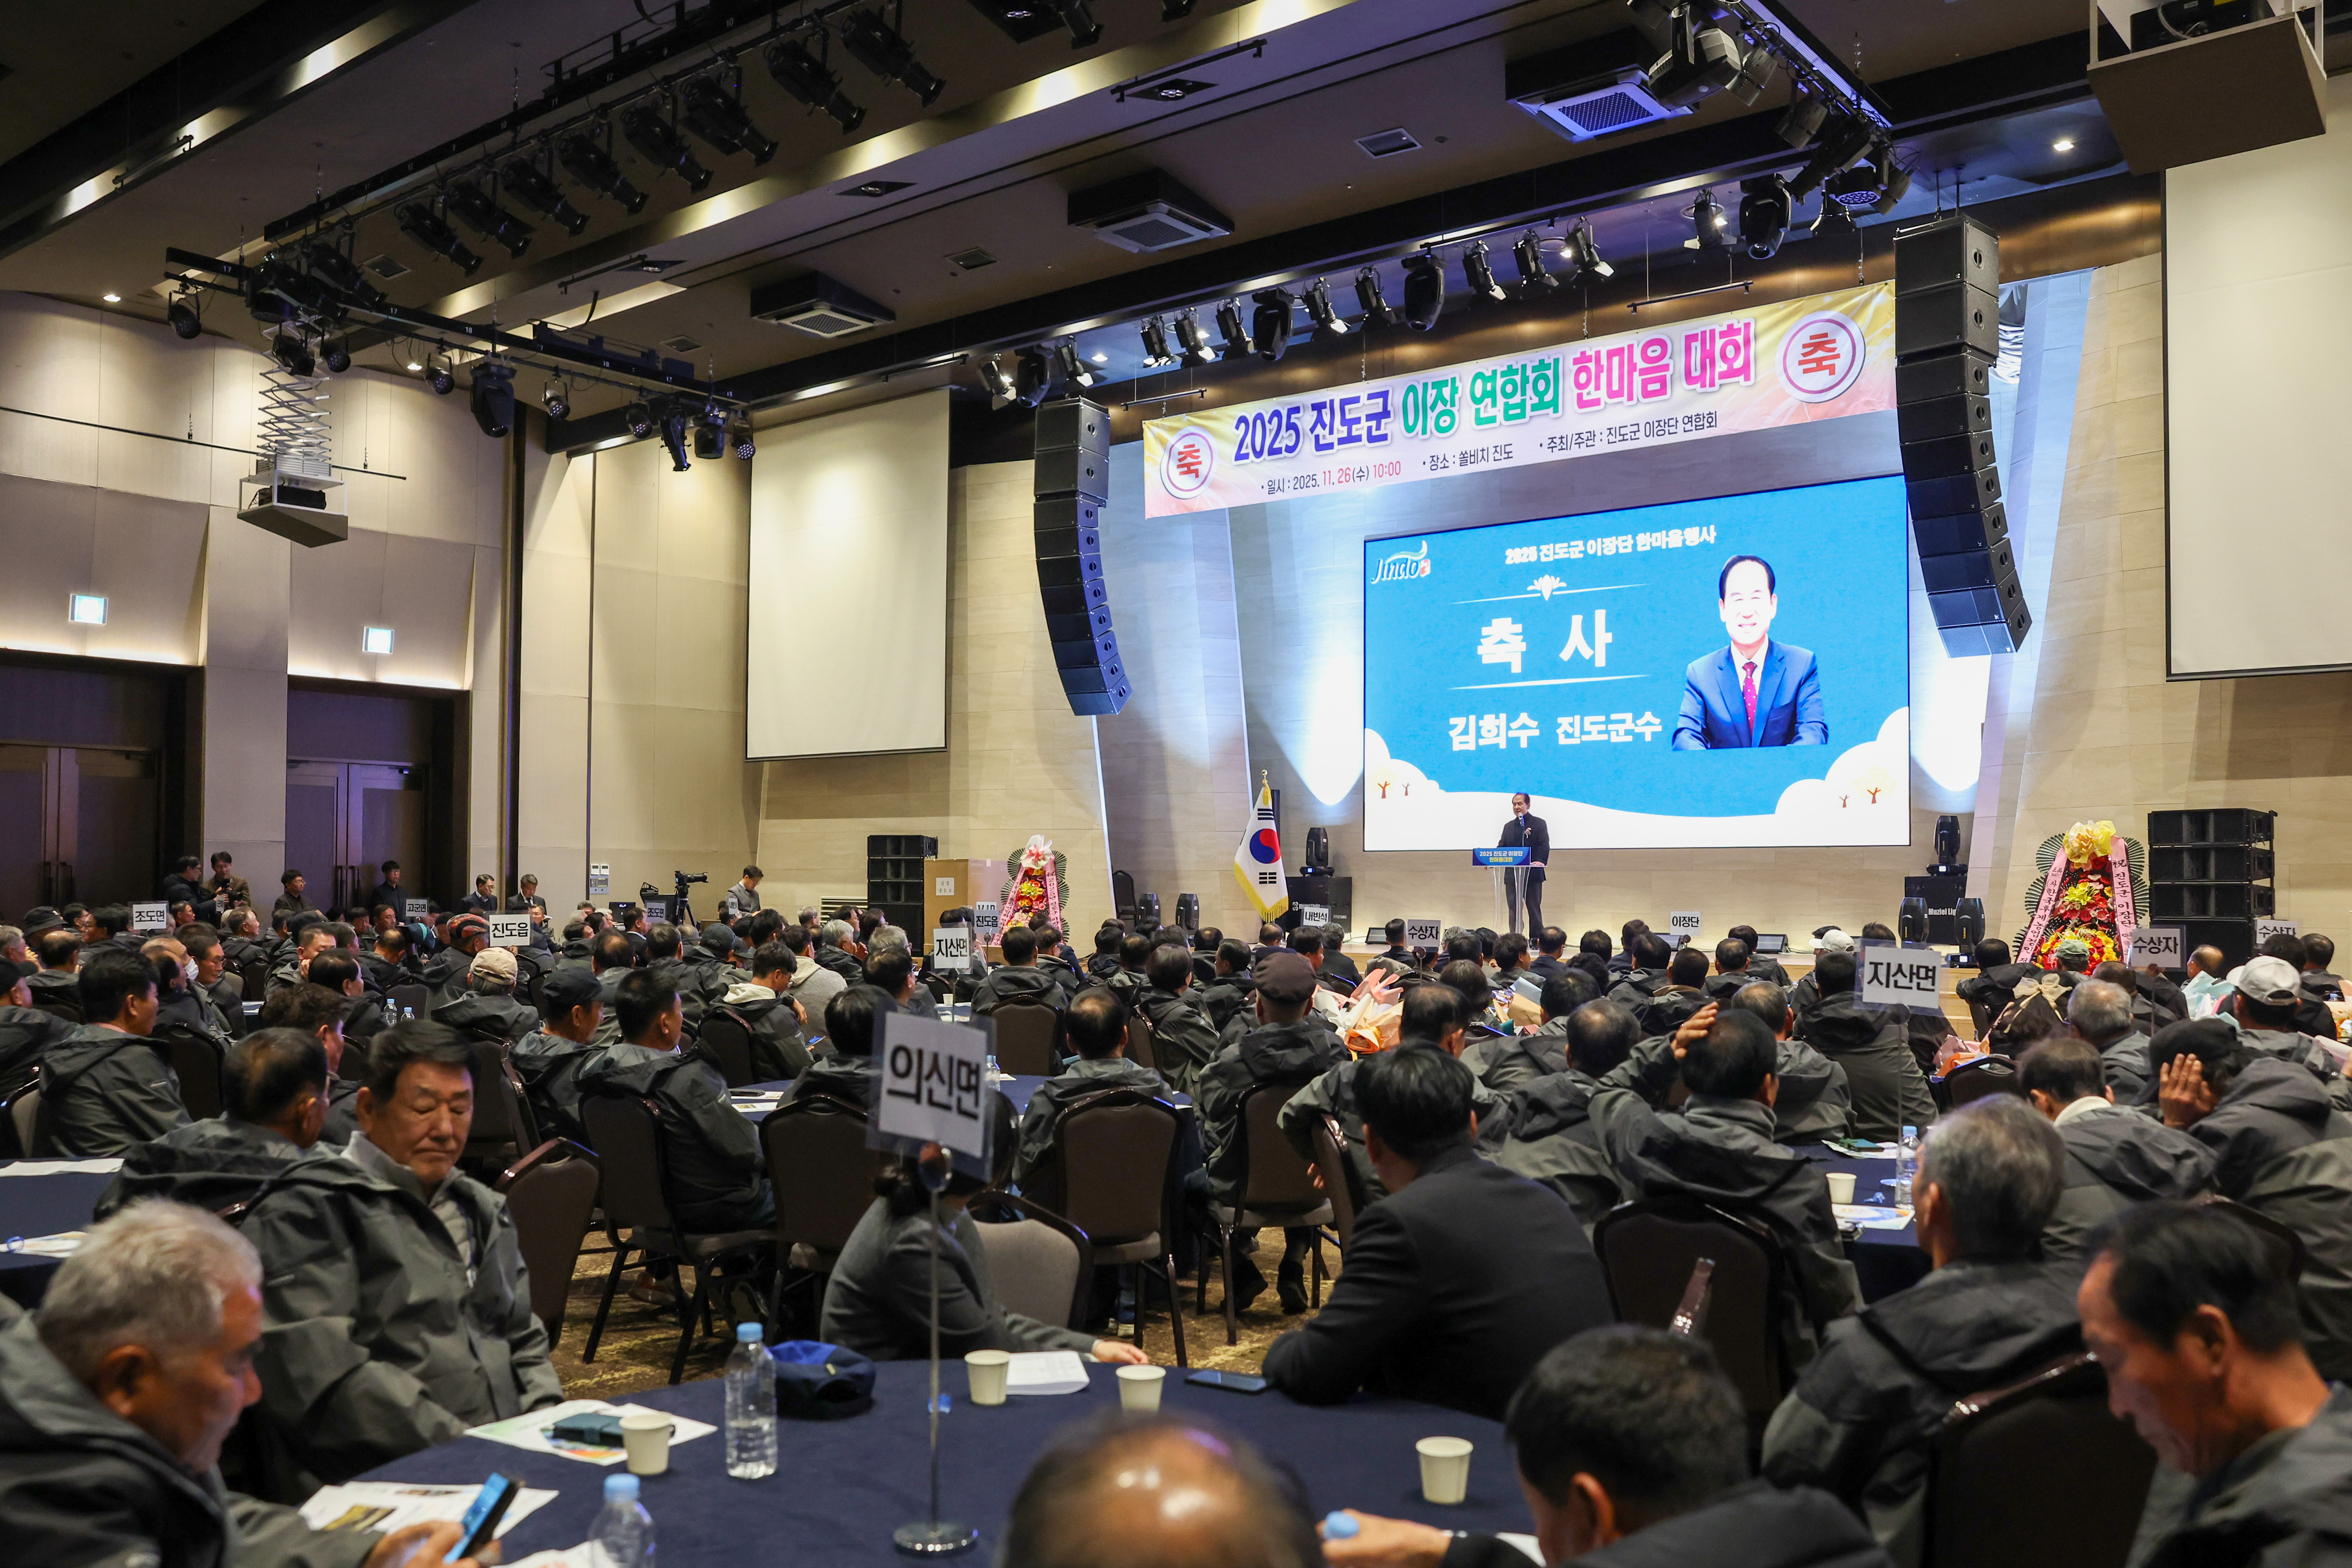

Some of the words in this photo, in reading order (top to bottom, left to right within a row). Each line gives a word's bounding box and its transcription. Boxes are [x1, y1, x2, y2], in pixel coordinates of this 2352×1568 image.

[223, 265, 232, 273] 17
[1799, 333, 1839, 375] 축
[1235, 407, 1300, 461] 2025
[1310, 390, 1390, 451] 진도군
[1403, 377, 1458, 435] 이장
[1470, 358, 1559, 425] 연합회
[1573, 339, 1669, 408] 한마음
[1685, 323, 1750, 388] 대회
[1548, 430, 1596, 453] 주최/주관
[1607, 423, 1640, 444] 진도군
[1645, 417, 1678, 437] 이장단
[1682, 411, 1717, 432] 연합회
[1178, 445, 1201, 477] 축
[1430, 454, 1449, 470] 장소
[1459, 447, 1488, 466] 쏠비치
[1493, 444, 1513, 461] 진도
[1268, 478, 1284, 494] 일시
[1294, 474, 1319, 490] 2025.
[1323, 470, 1334, 485] 11.
[1374, 461, 1400, 477] 10:00
[1505, 548, 1537, 564] 2025
[1539, 541, 1585, 561] 진도군
[1587, 535, 1633, 556] 이장단
[1636, 525, 1717, 551] 한마음행사
[1449, 713, 1539, 751] 김희수
[1556, 711, 1662, 744] 진도군수
[2112, 859, 2127, 868] 祝
[2114, 872, 2130, 897] 진도군
[135, 910, 164, 922] 조도면
[407, 904, 426, 912] 고군면
[648, 908, 664, 918] 조도면
[1305, 912, 1327, 922] 내빈석
[2118, 902, 2134, 927] 이장단
[492, 923, 528, 938] 진도읍
[976, 916, 998, 927] 진도읍
[1672, 916, 1699, 927] 이장단
[1408, 926, 1439, 940] 수상자
[936, 938, 968, 957] 지산면
[2134, 937, 2178, 954] 수상자
[1867, 962, 1936, 992] 지산면
[887, 1045, 980, 1121] 의신면
